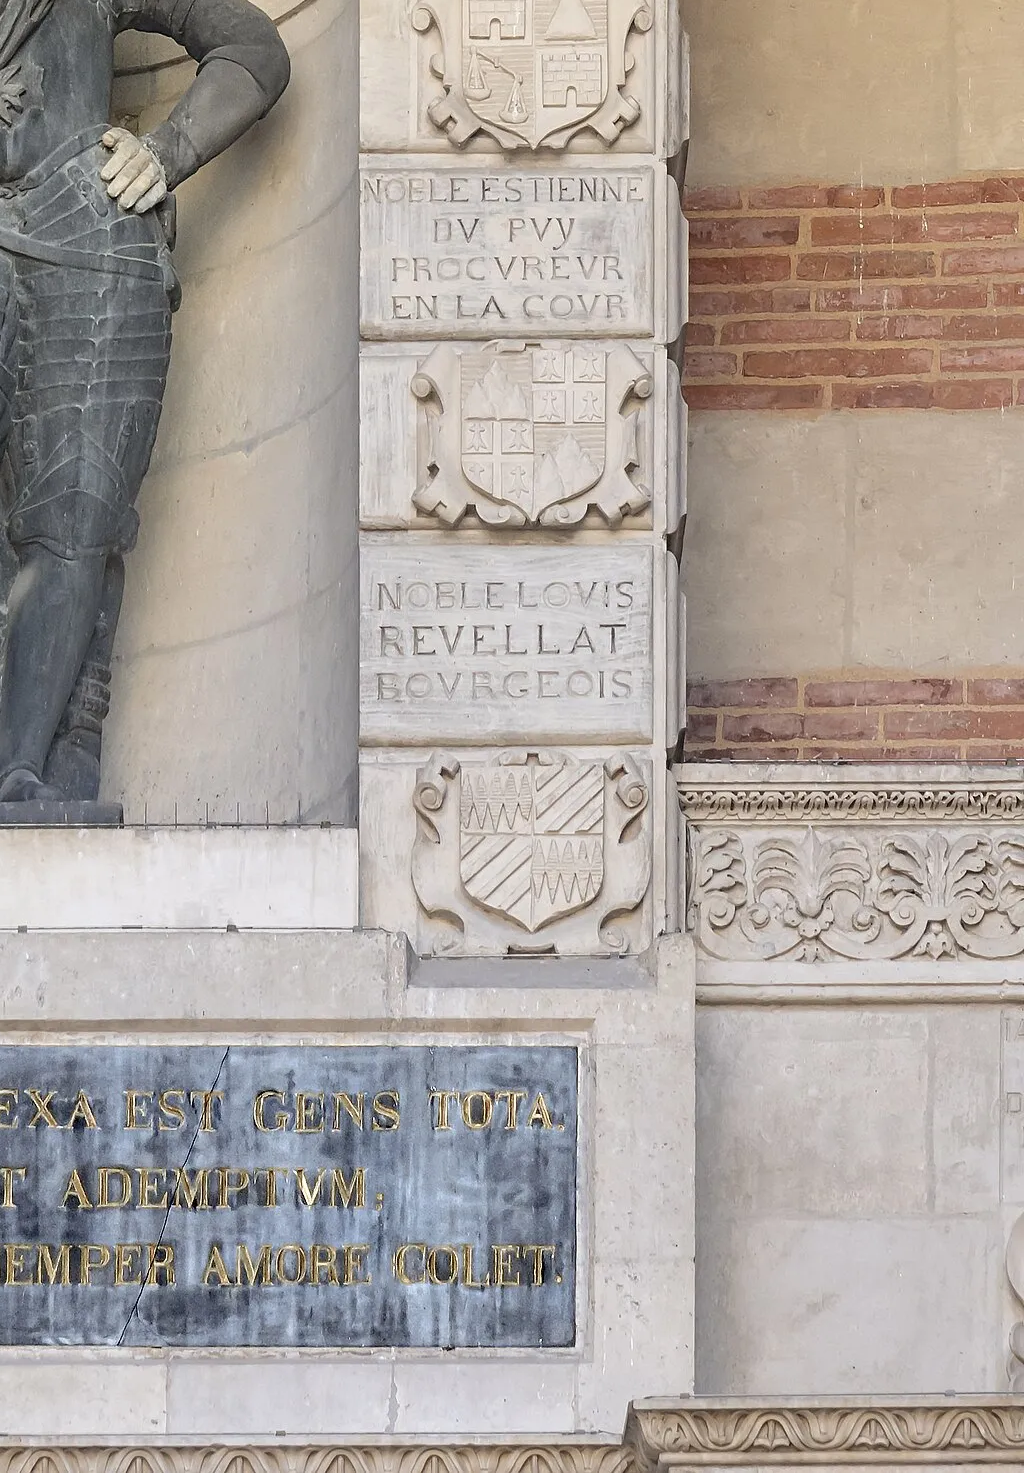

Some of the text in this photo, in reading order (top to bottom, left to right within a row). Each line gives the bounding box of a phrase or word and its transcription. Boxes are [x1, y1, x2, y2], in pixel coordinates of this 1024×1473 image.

[481, 177, 644, 202] ESTIENNE
[434, 218, 479, 244] DV
[392, 256, 623, 282] PROCVREVR
[392, 295, 626, 319] EN LA COVR
[377, 581, 634, 610] NOBLE LOVIS
[379, 624, 626, 656] REVELLAT
[376, 670, 632, 700] BOVRGEOIS
[122, 1089, 224, 1132] EST
[253, 1090, 401, 1132] GENS
[428, 1090, 566, 1131] TOTA.
[202, 1243, 374, 1286] AMORE
[391, 1243, 563, 1286] COLET.
